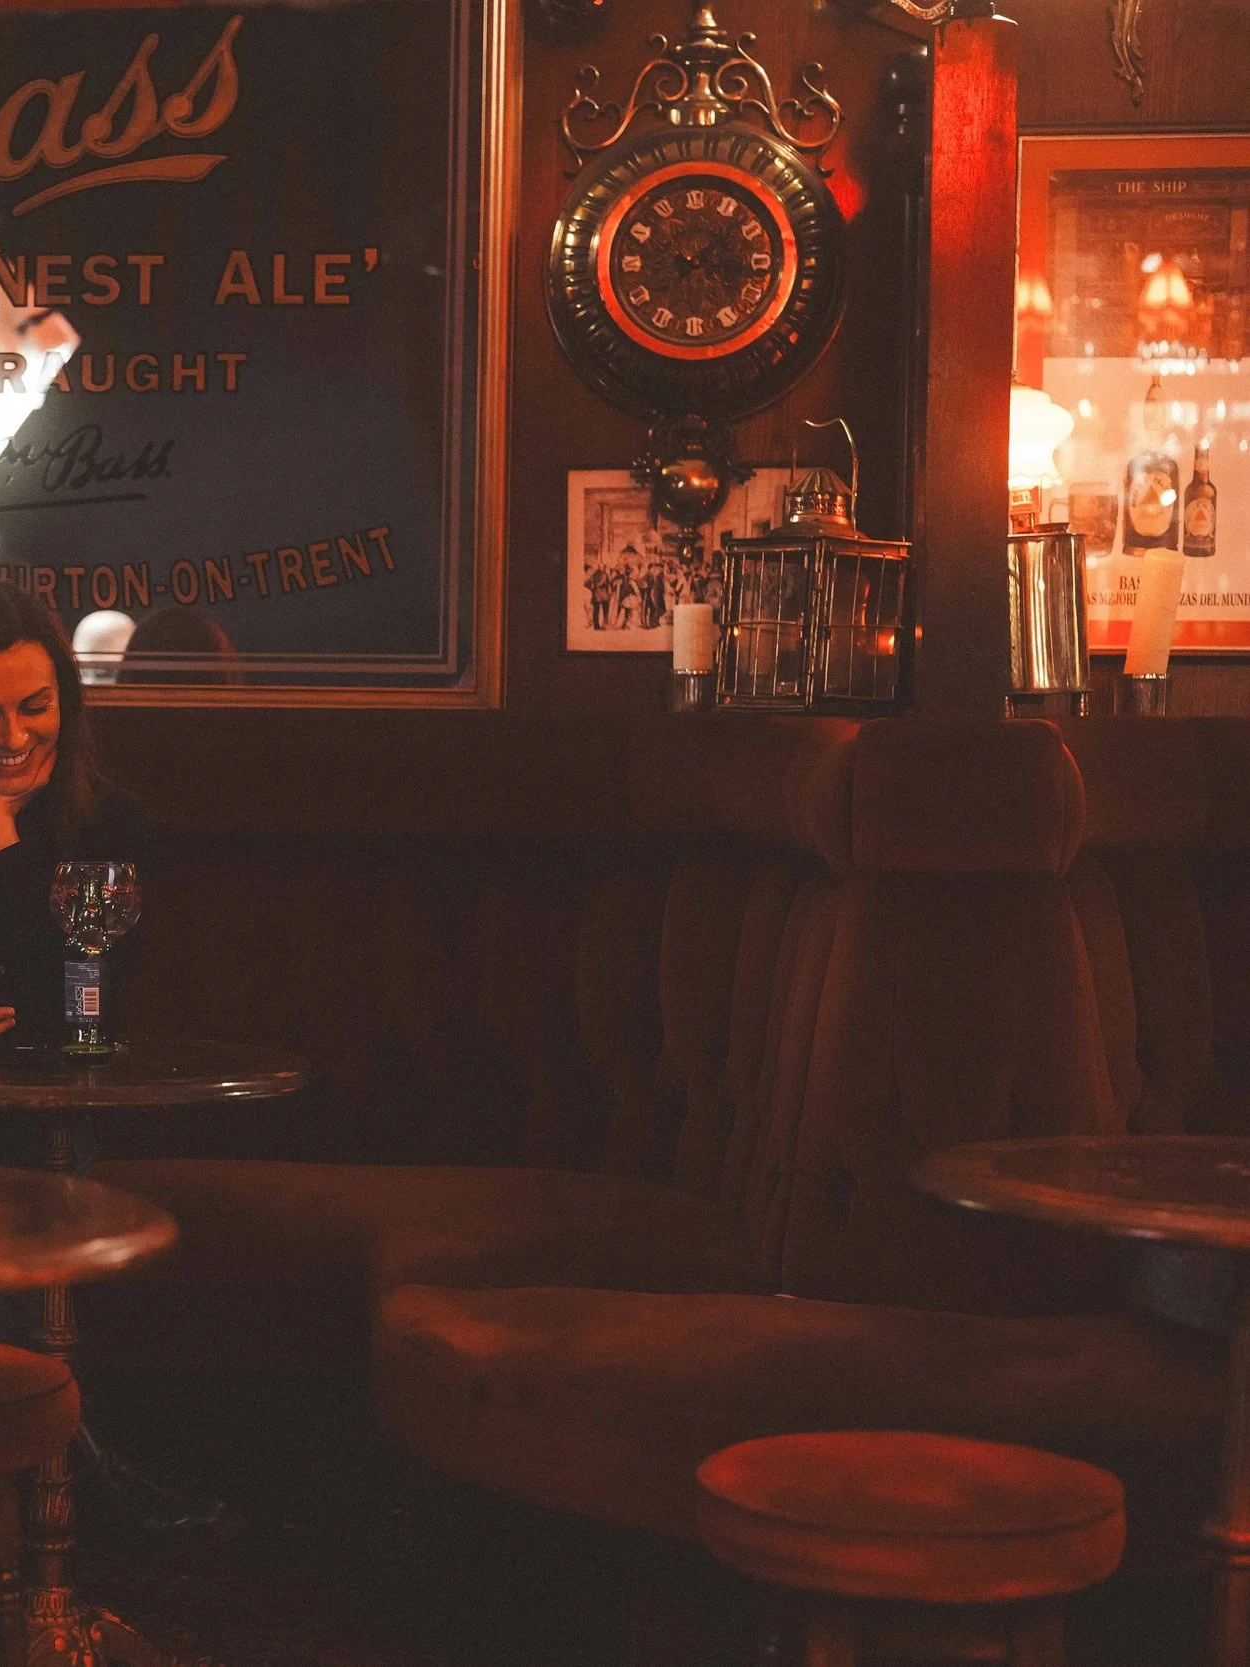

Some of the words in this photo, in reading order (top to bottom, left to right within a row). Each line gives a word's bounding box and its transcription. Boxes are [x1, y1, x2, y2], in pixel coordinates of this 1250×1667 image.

[1116, 181, 1147, 194] THE
[1153, 180, 1187, 193] SHIP
[1200, 592, 1220, 606] DEL
